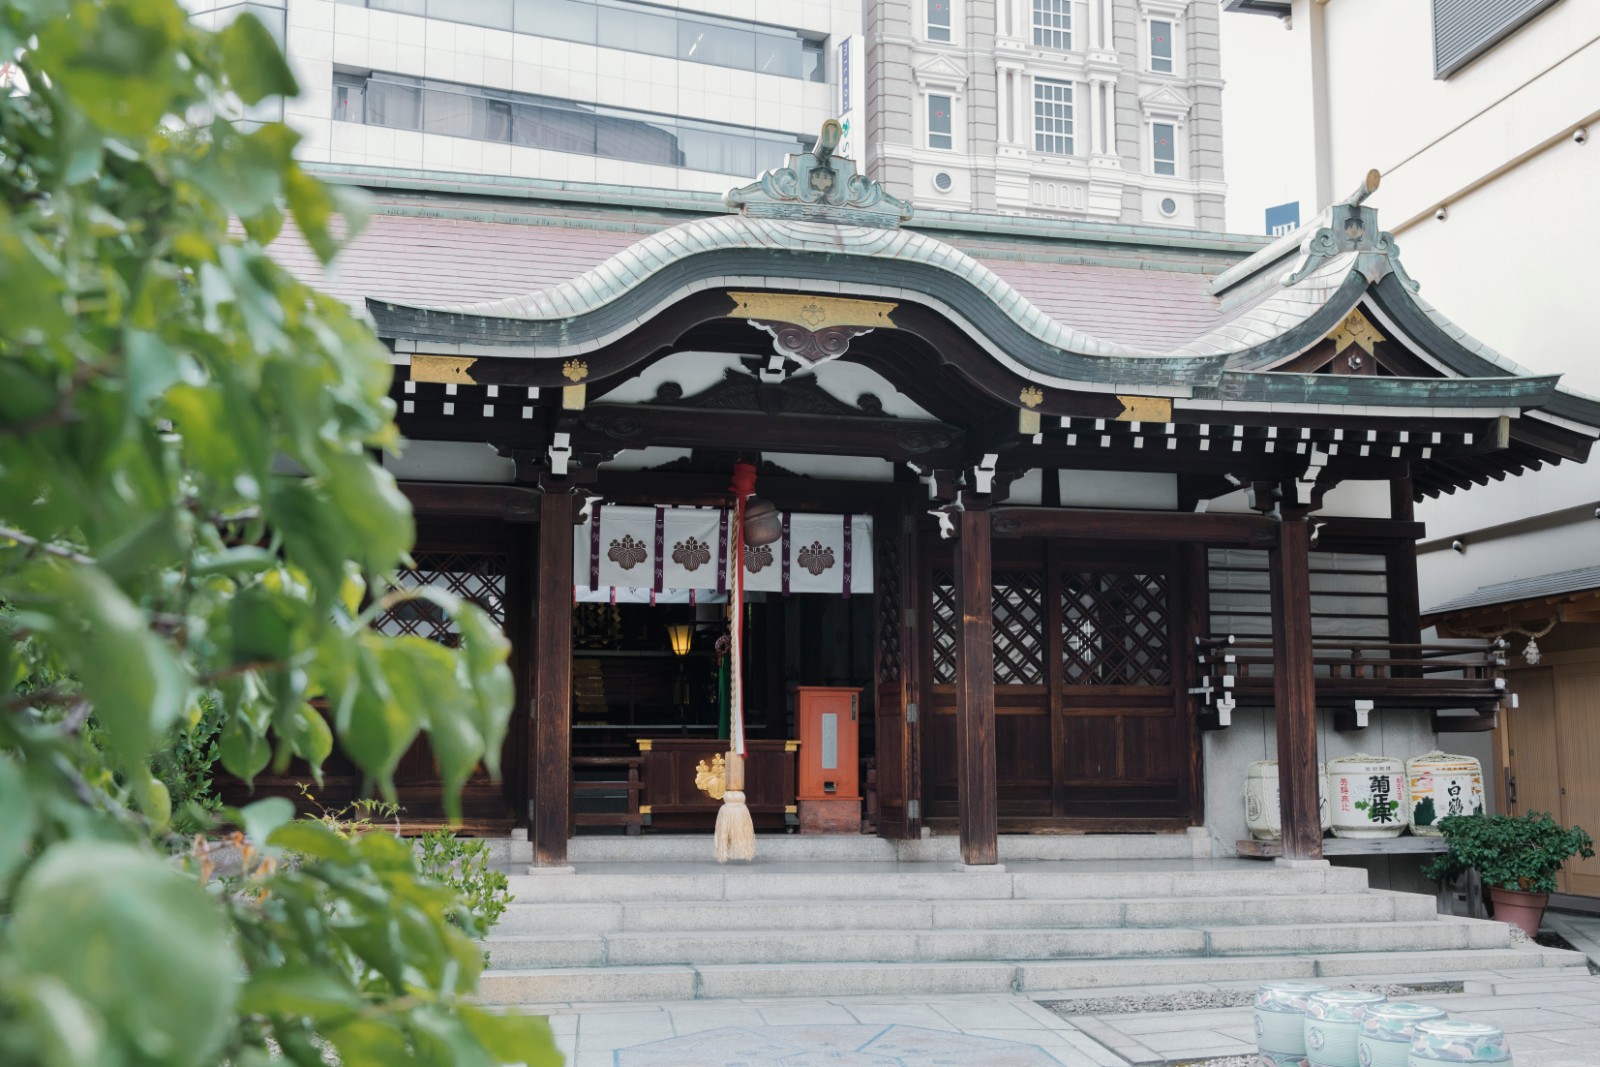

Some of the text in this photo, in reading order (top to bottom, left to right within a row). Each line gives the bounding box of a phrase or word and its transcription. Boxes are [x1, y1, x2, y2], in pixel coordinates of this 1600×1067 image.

[1369, 775, 1393, 824] 菊正宗
[1447, 780, 1464, 813] 白鶴
